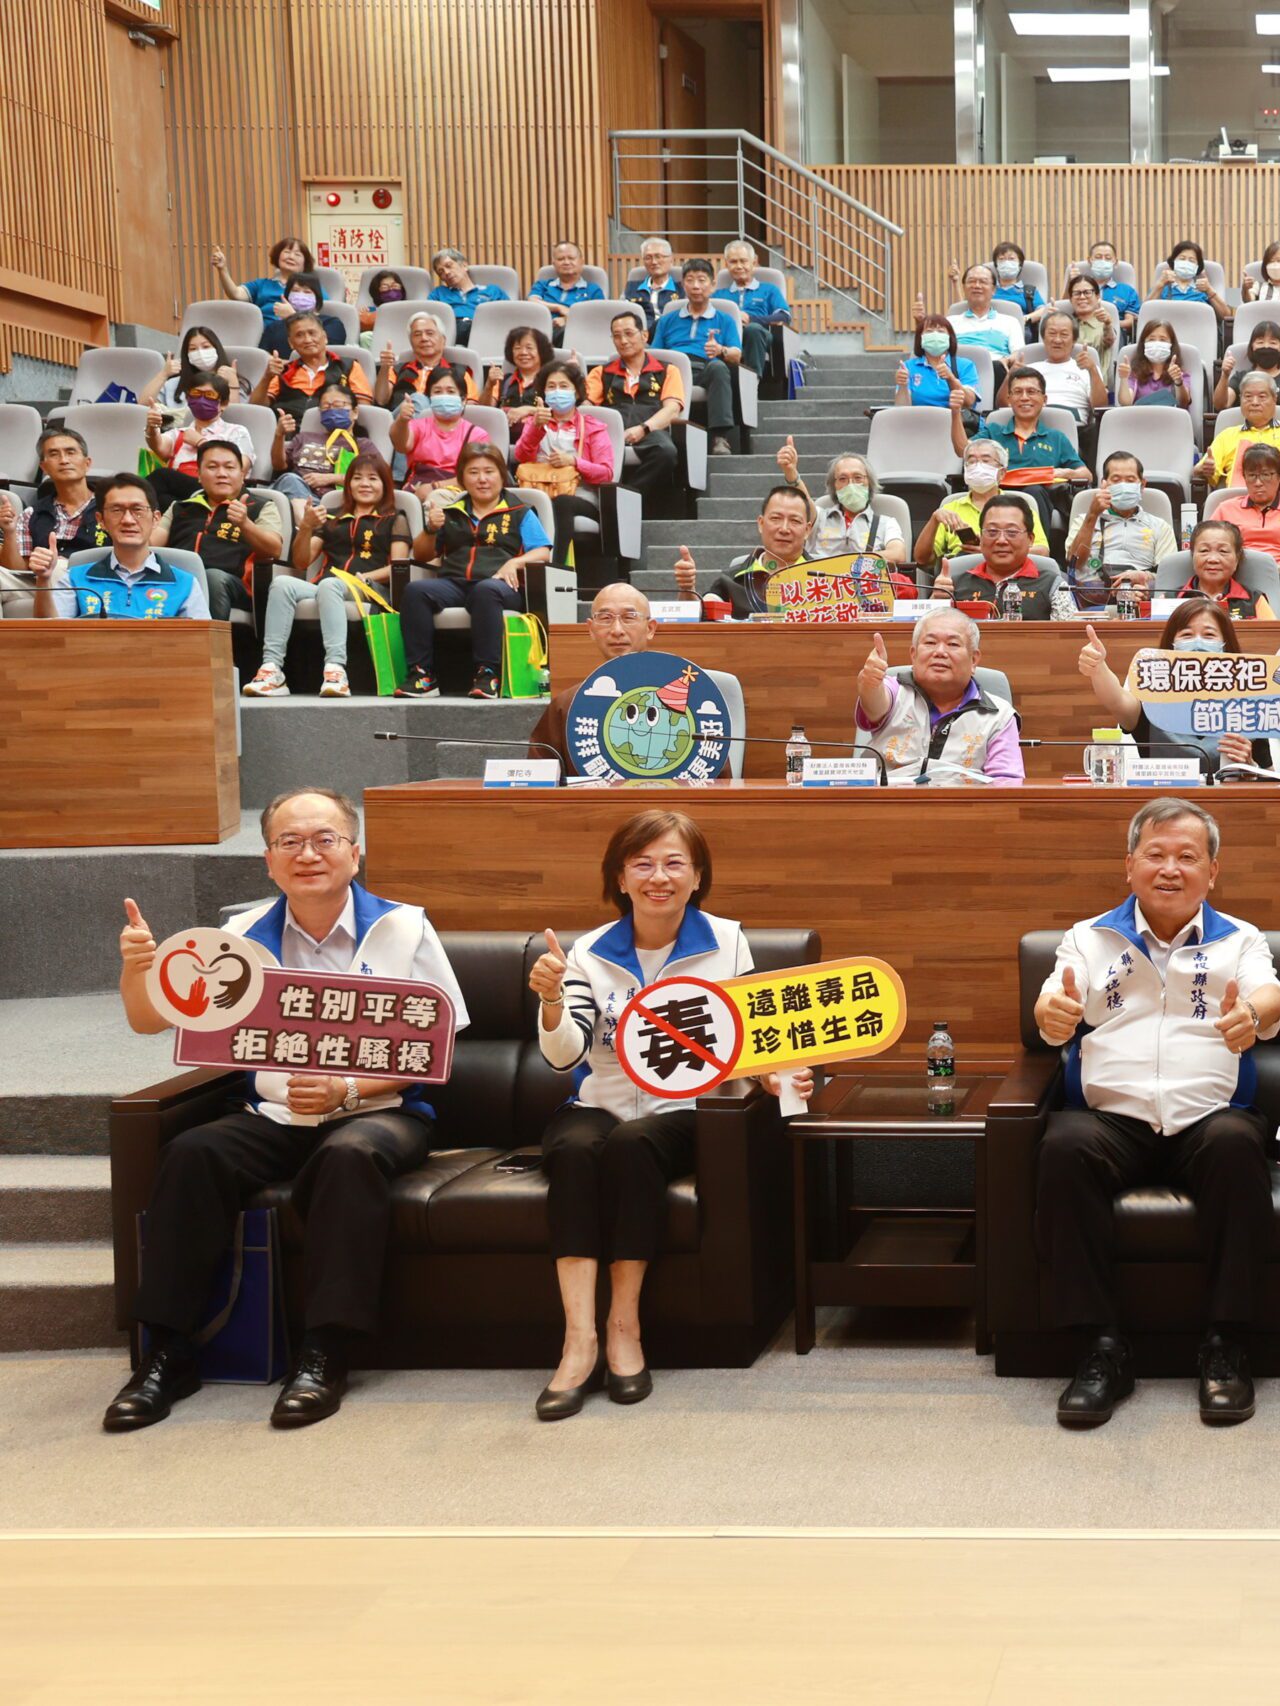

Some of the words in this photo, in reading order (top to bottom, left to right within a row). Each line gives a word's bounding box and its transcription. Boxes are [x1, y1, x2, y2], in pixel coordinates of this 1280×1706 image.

[332, 228, 385, 249] 消防栓
[333, 253, 385, 264] HYDRANT
[779, 570, 881, 608] 以米代金
[1138, 657, 1267, 692] 環保祭祀
[279, 984, 437, 1029] 性別平等
[747, 971, 881, 1019] 遠離毒品
[636, 994, 718, 1081] 毒
[751, 1008, 884, 1056] 珍惜生命
